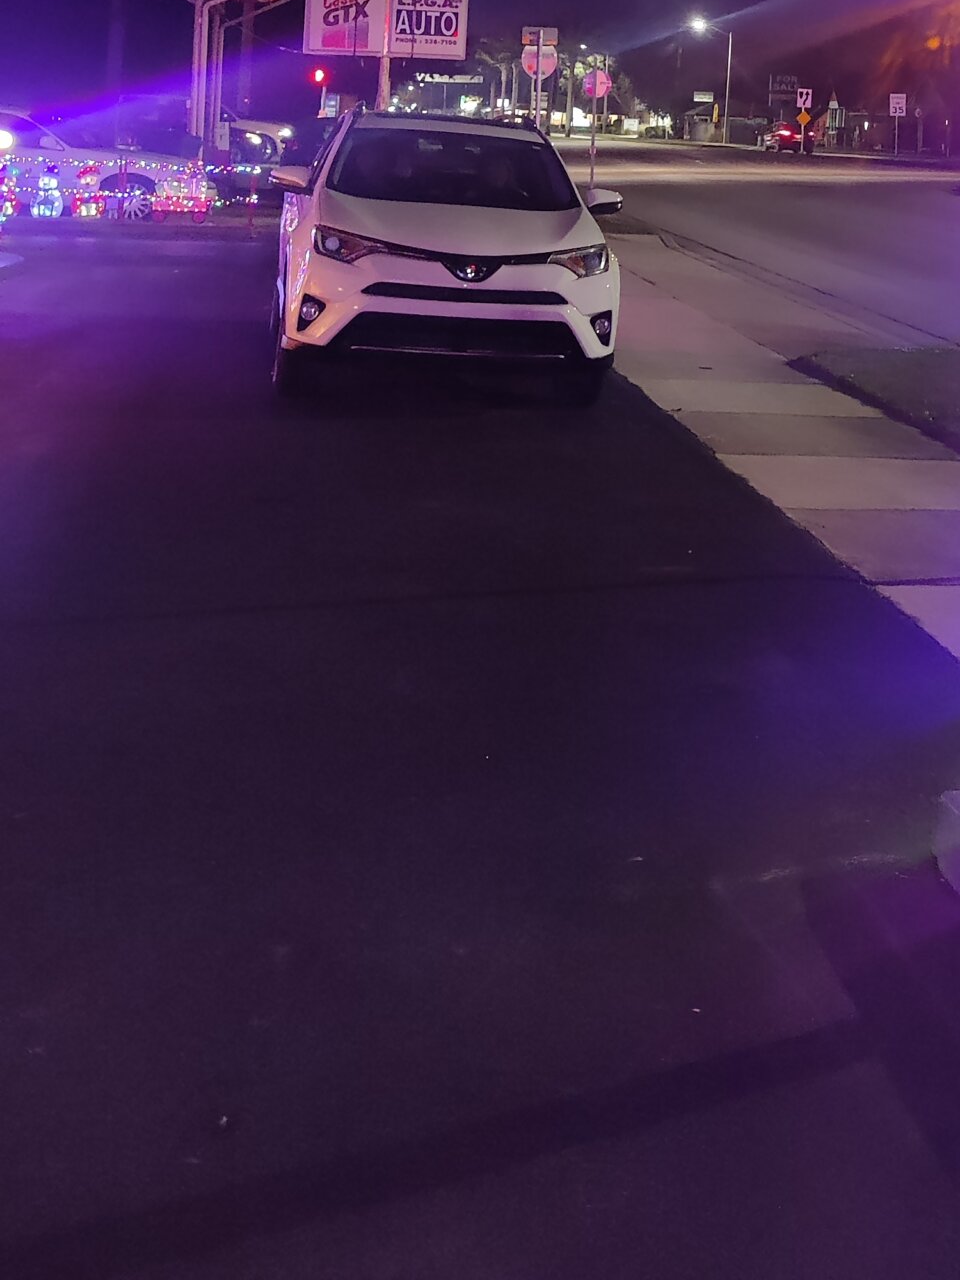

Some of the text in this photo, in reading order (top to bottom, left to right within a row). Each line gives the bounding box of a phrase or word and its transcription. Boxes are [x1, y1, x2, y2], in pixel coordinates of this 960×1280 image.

[322, 0, 370, 27] GTX
[396, 9, 457, 36] AUTO
[776, 74, 798, 84] FOR
[891, 105, 905, 115] 35
